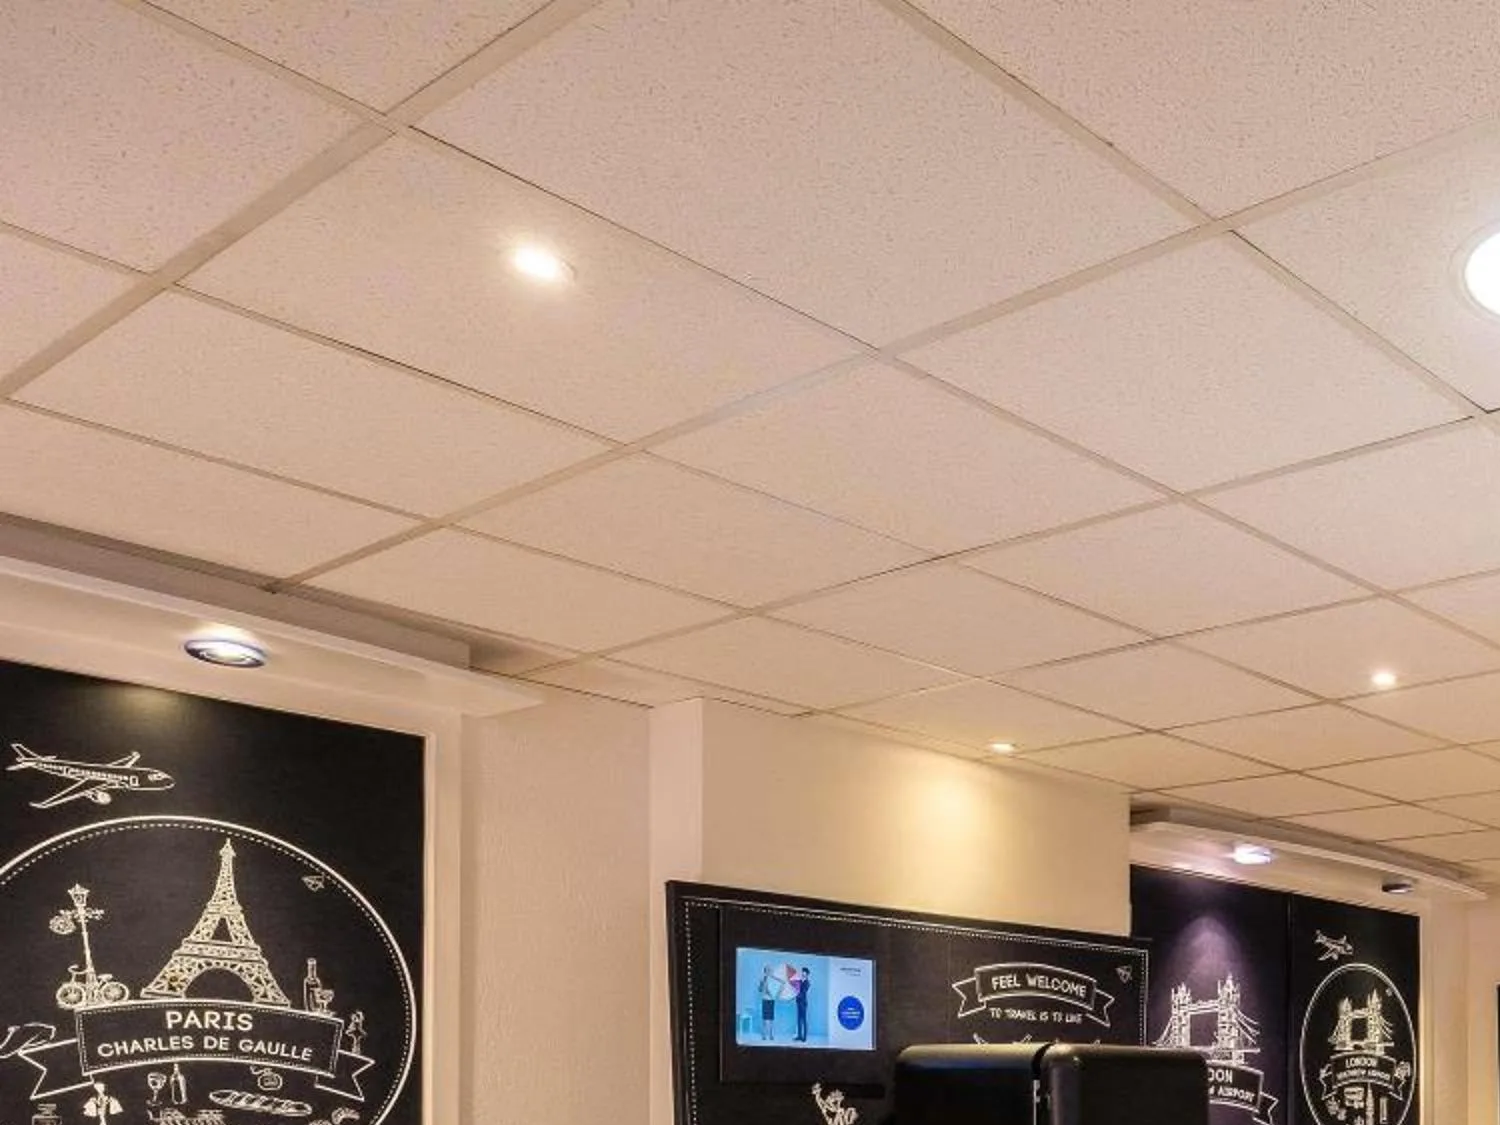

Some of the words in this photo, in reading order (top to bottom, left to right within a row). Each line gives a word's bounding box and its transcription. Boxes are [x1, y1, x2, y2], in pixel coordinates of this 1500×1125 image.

[991, 974, 1021, 990] FEEL
[1026, 974, 1087, 998] WELCOME
[166, 1010, 253, 1031] PARIS
[989, 1007, 1001, 1019] TO
[98, 1035, 194, 1057] CHARLES
[203, 1036, 230, 1050] DE
[238, 1039, 313, 1061] GAULLE
[1218, 1085, 1255, 1102] AIRPORT
